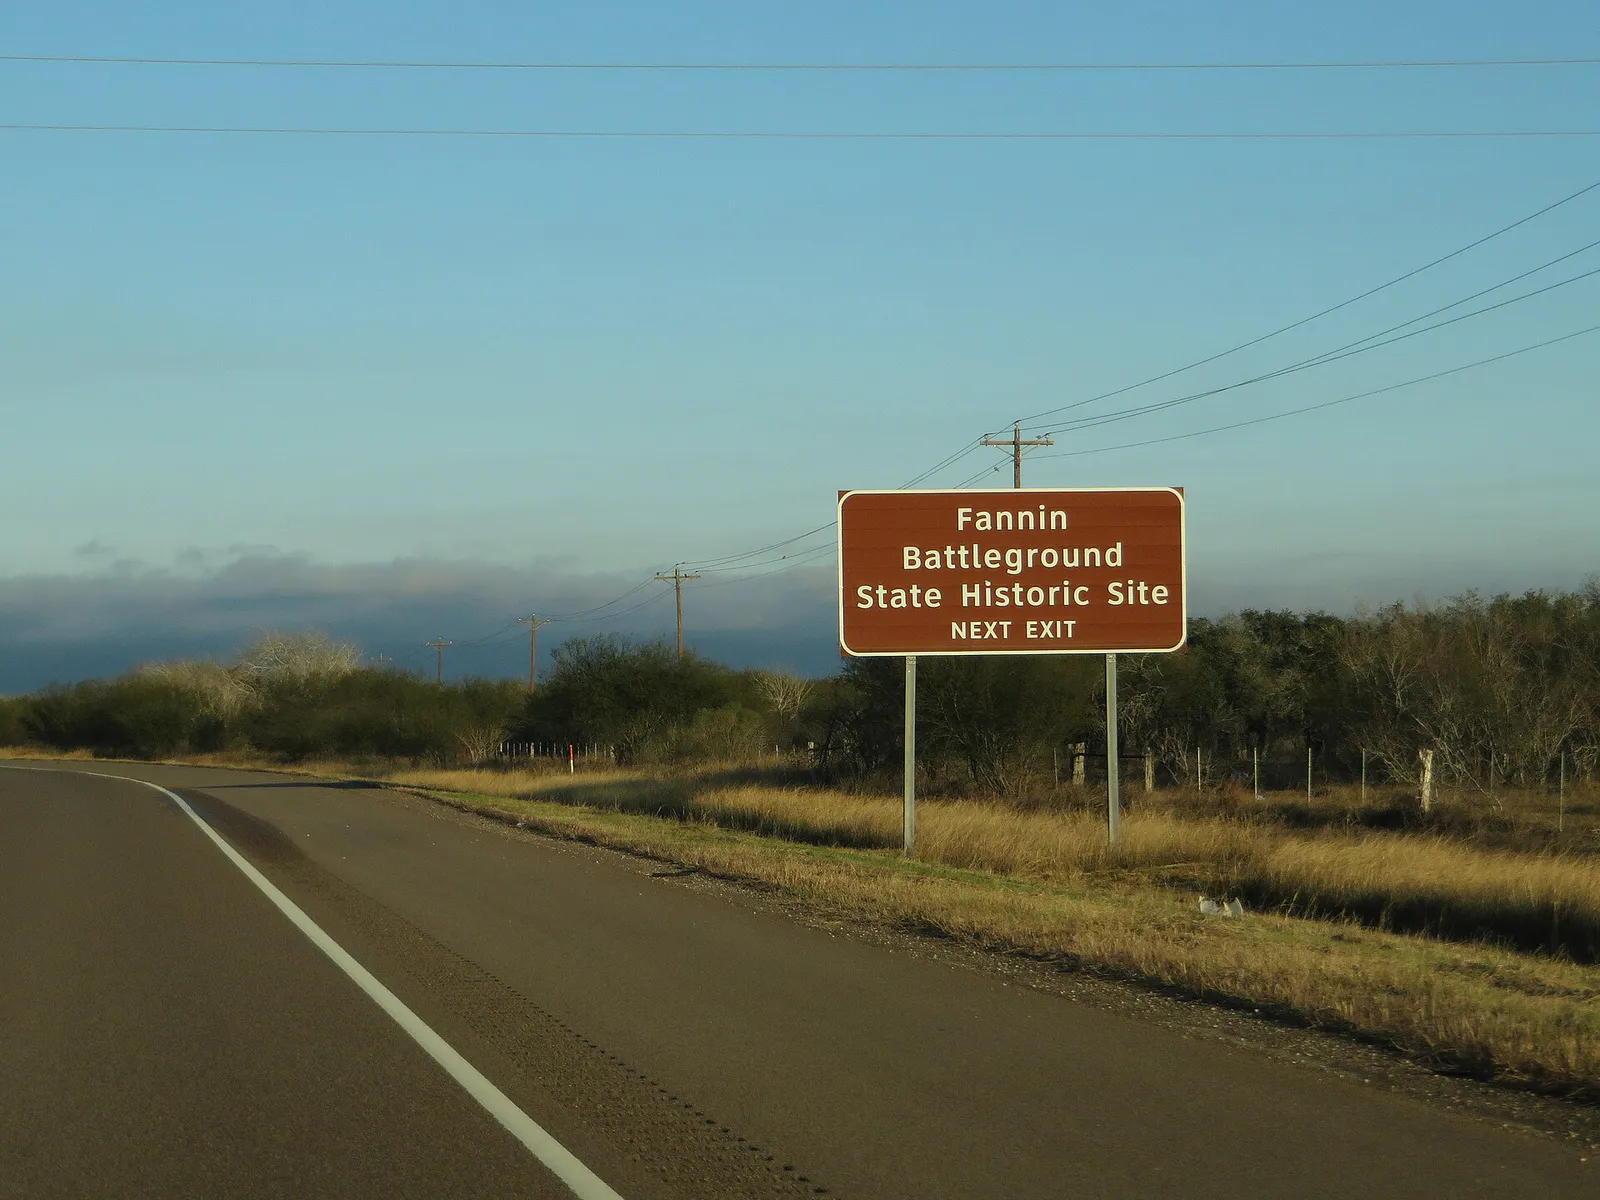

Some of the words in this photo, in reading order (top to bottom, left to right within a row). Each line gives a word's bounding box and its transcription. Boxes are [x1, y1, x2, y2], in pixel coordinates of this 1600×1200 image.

[957, 504, 1067, 531] Fannin
[902, 542, 1123, 574] Battleground
[856, 584, 942, 609] State
[961, 580, 1090, 606] Historic
[1107, 579, 1169, 605] Site
[951, 621, 1012, 639] NEXT
[1026, 620, 1077, 638] EXIT
